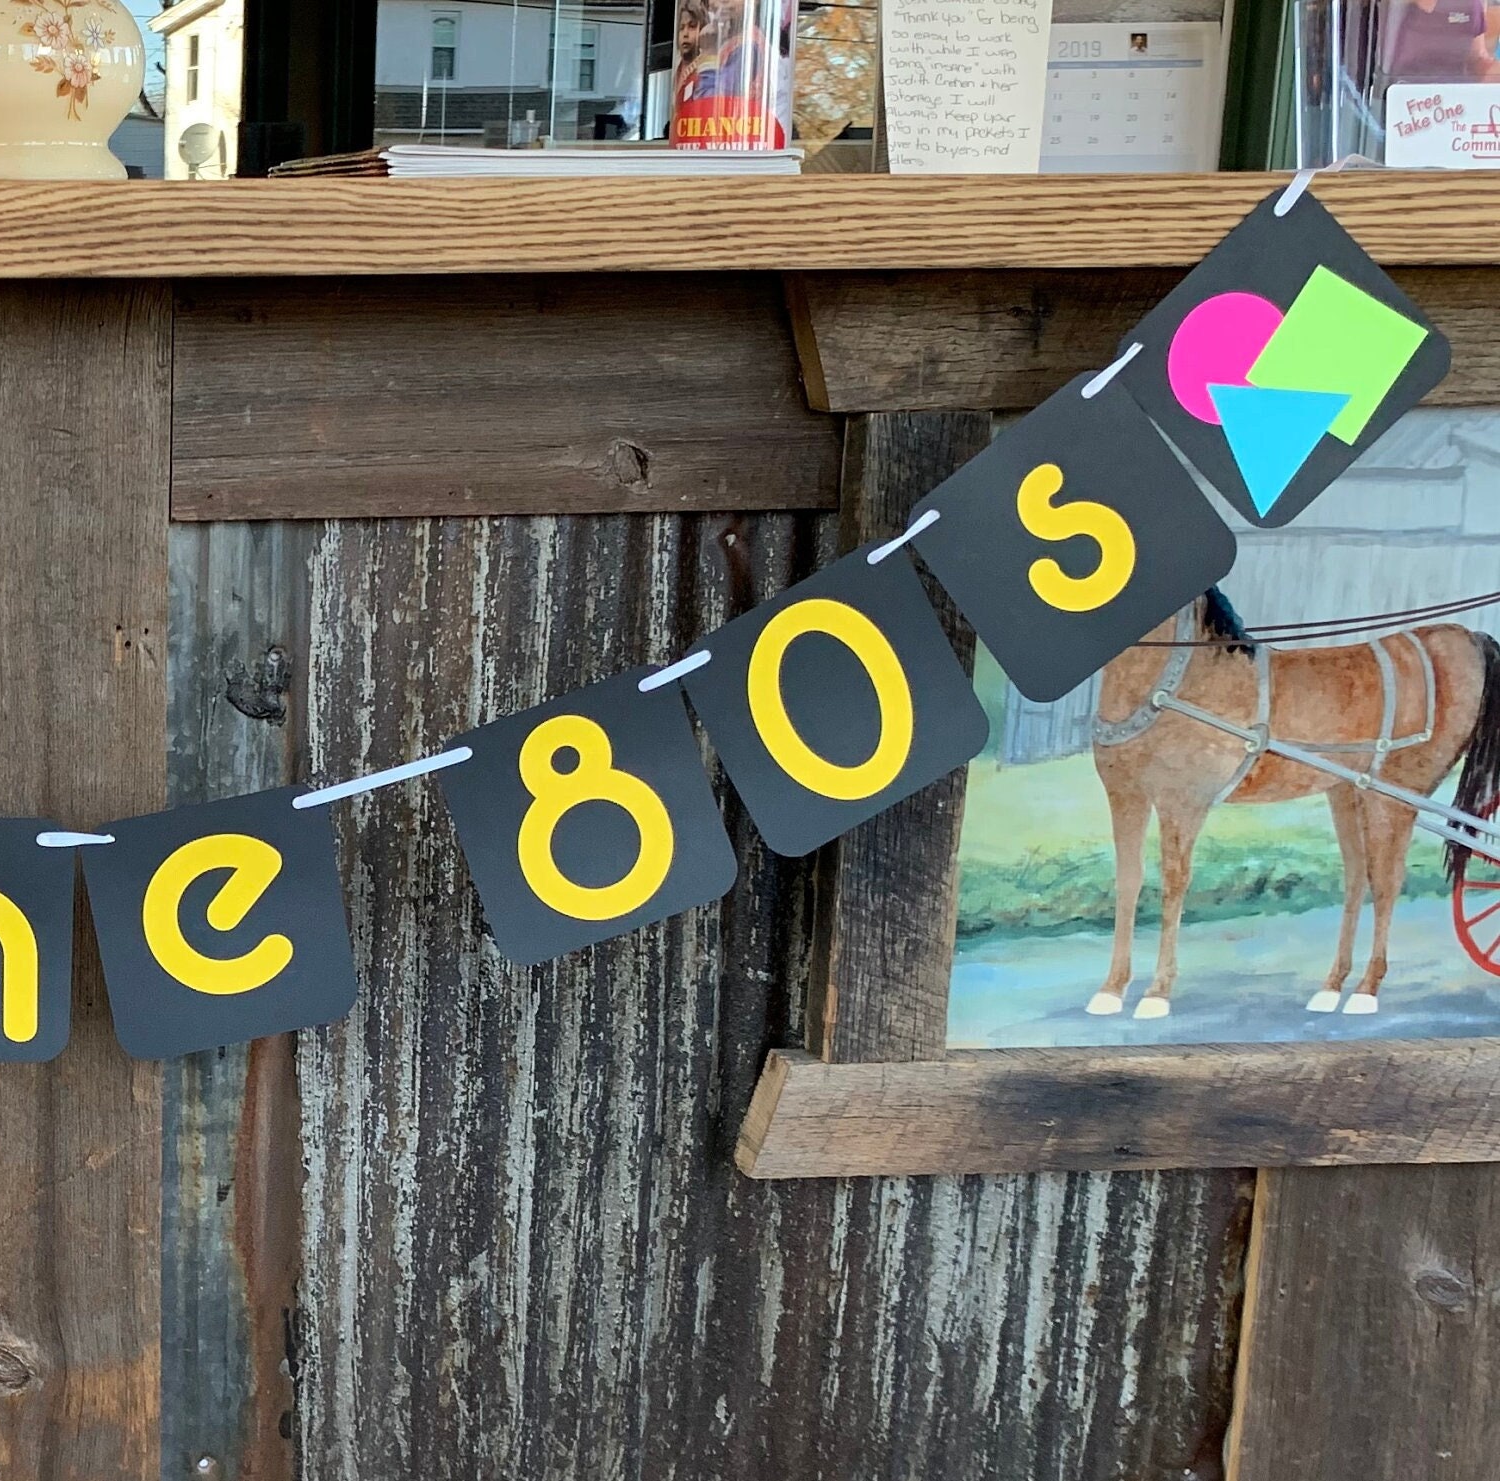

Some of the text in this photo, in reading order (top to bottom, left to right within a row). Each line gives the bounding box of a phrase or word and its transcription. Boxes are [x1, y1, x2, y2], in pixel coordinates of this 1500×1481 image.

[1000, 10, 1039, 33] being
[956, 30, 970, 42] to
[978, 32, 1012, 43] work
[889, 42, 925, 55] with
[929, 43, 962, 56] while
[966, 46, 980, 57] I
[1058, 40, 1101, 58] 2019
[981, 65, 1016, 75] with
[950, 94, 964, 105] I
[967, 95, 996, 106] will
[1406, 94, 1442, 115] Free
[1394, 103, 1465, 137] Take One
[1452, 121, 1467, 132] The
[887, 121, 911, 135] nfo
[917, 127, 930, 136] in
[916, 138, 931, 152] to
[935, 142, 980, 159] buyers
[1452, 137, 1500, 152] Comm
[889, 154, 925, 166] ellers
